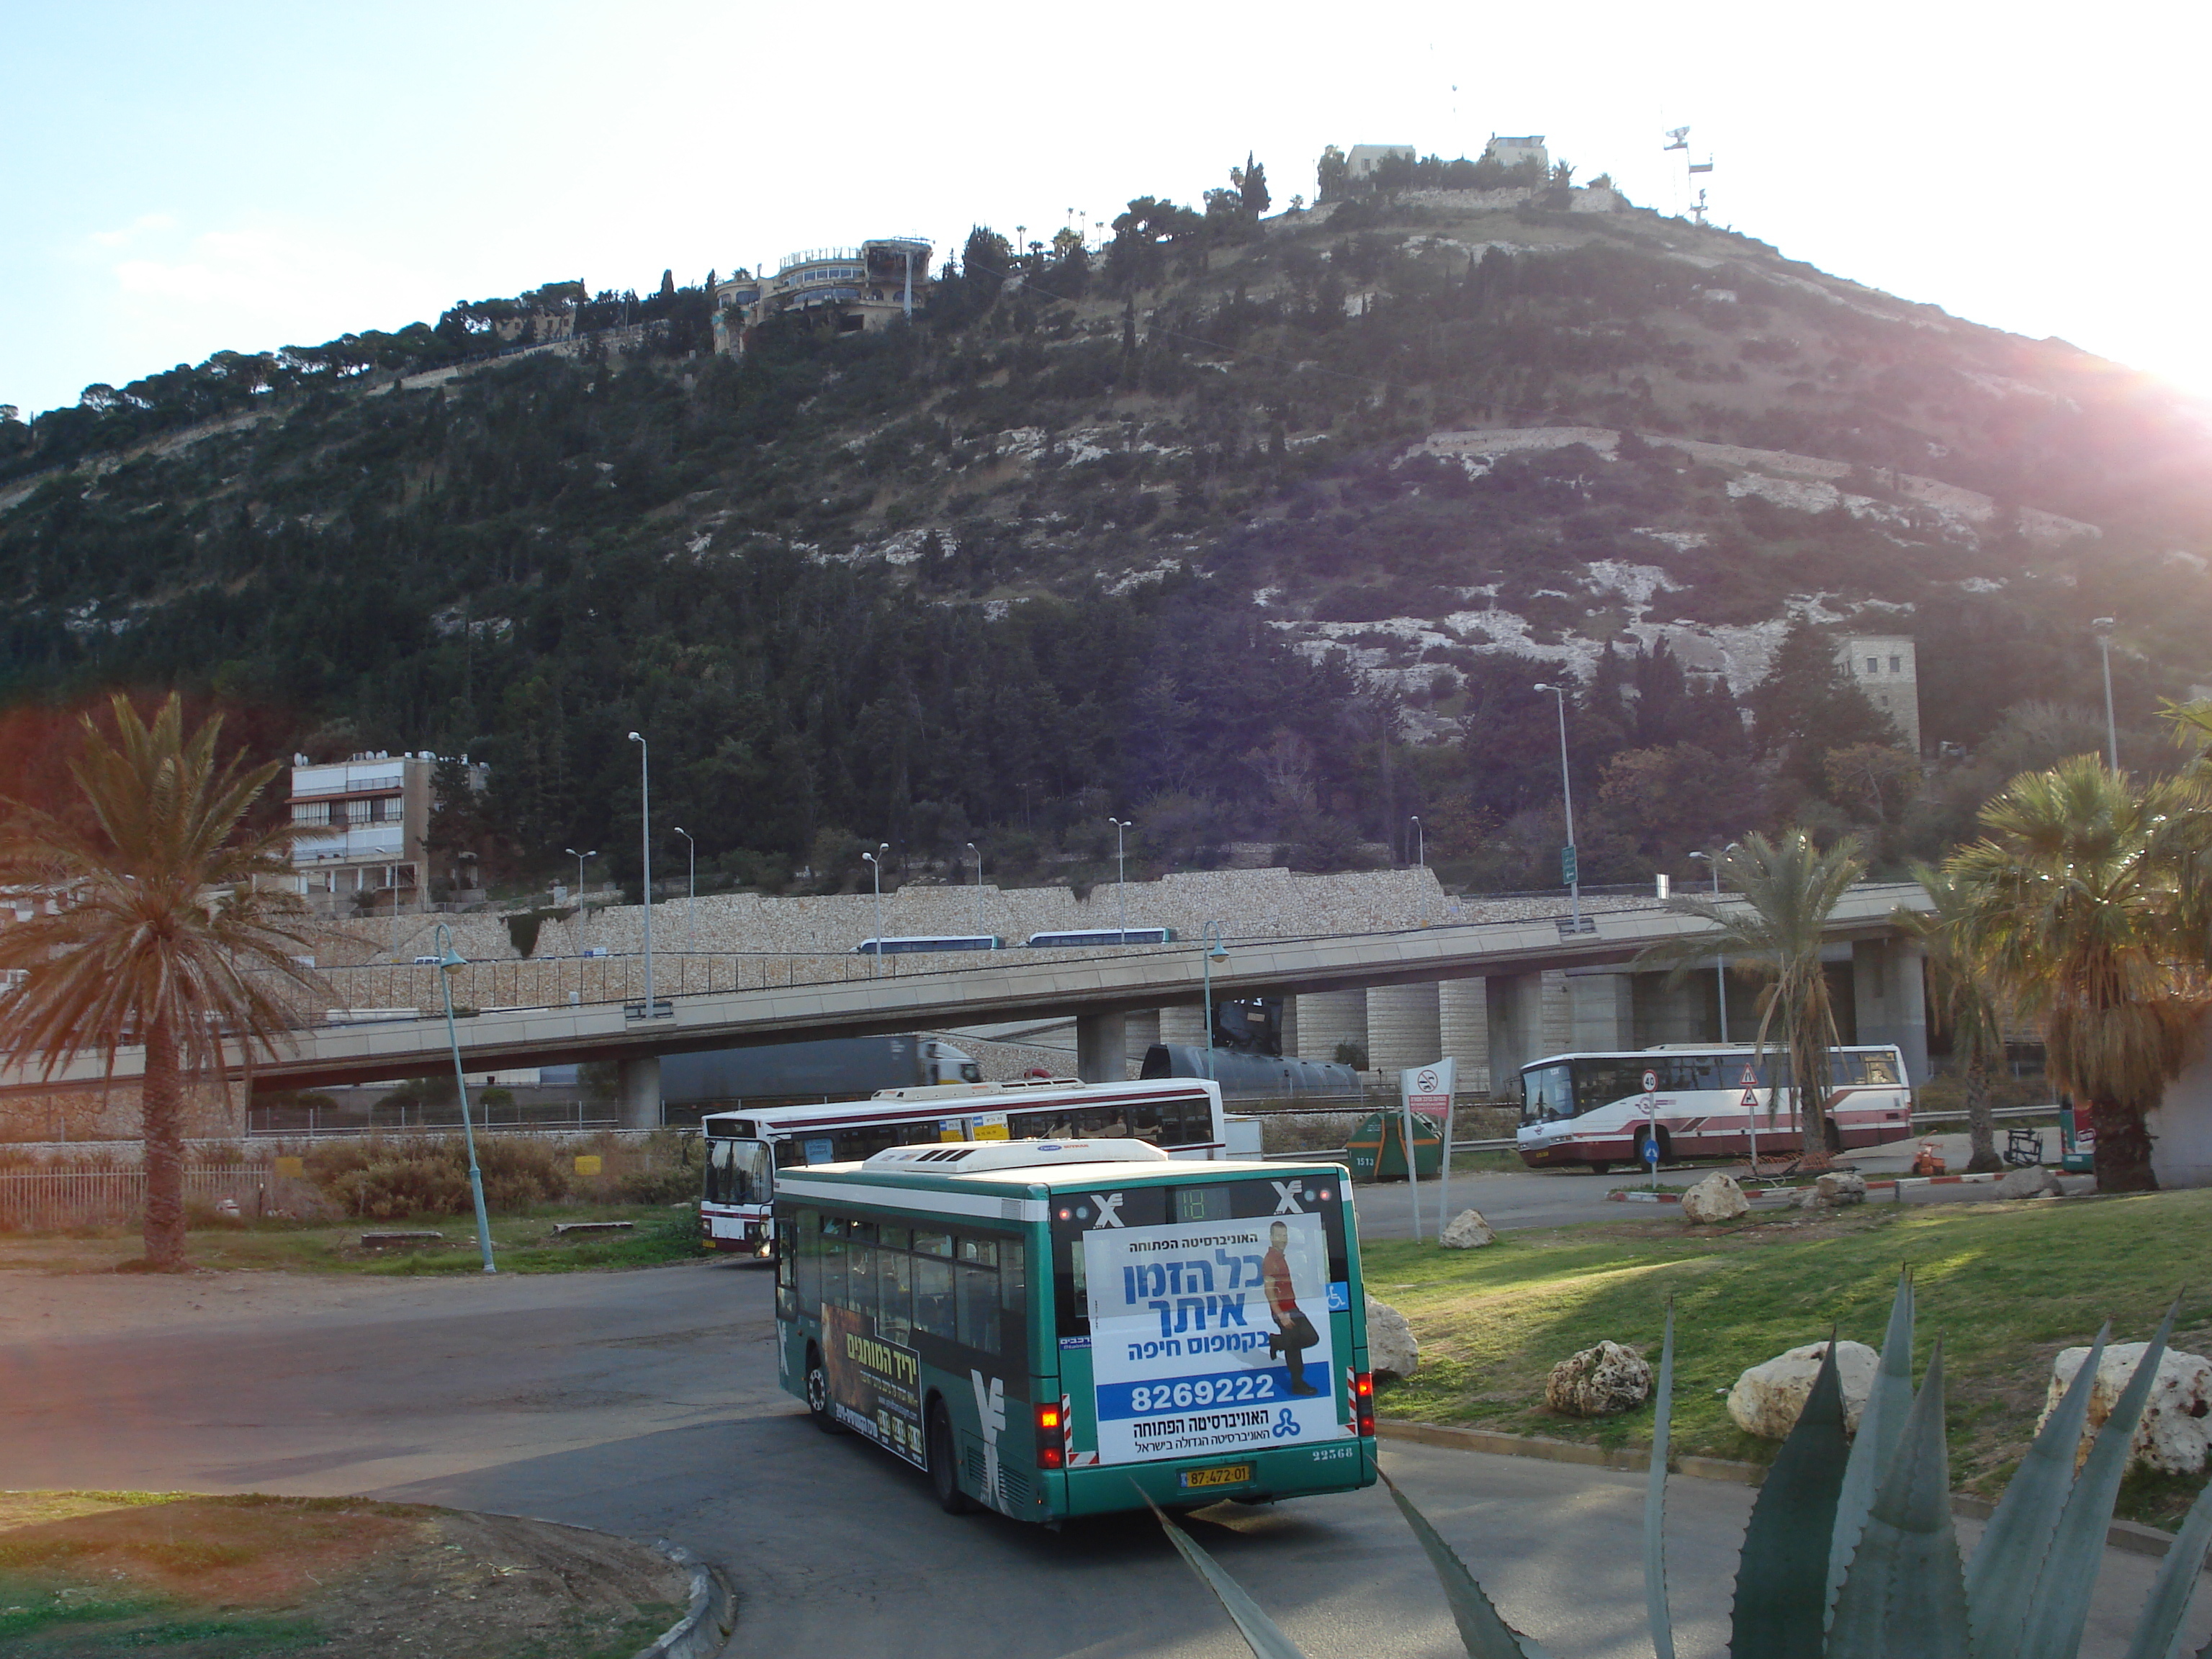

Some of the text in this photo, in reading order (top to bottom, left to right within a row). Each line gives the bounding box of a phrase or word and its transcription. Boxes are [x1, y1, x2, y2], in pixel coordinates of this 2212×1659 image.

[1645, 1076, 1655, 1086] 40
[1357, 1157, 1374, 1166] 1513
[1183, 1189, 1205, 1219] 18
[1129, 1233, 1259, 1253] האוניברסיטה הפתוחה
[1123, 1248, 1265, 1305] כל הזמן
[1148, 1292, 1248, 1338] איתך
[1128, 1331, 1270, 1361] בקמפוס חיפה
[893, 1350, 917, 1385] יריד
[1131, 1374, 1275, 1411] 8269222
[1133, 1409, 1269, 1439] האוניברסיטה הפתוחה
[1135, 1429, 1270, 1454] האוניברסיטה הגדולה בישראל
